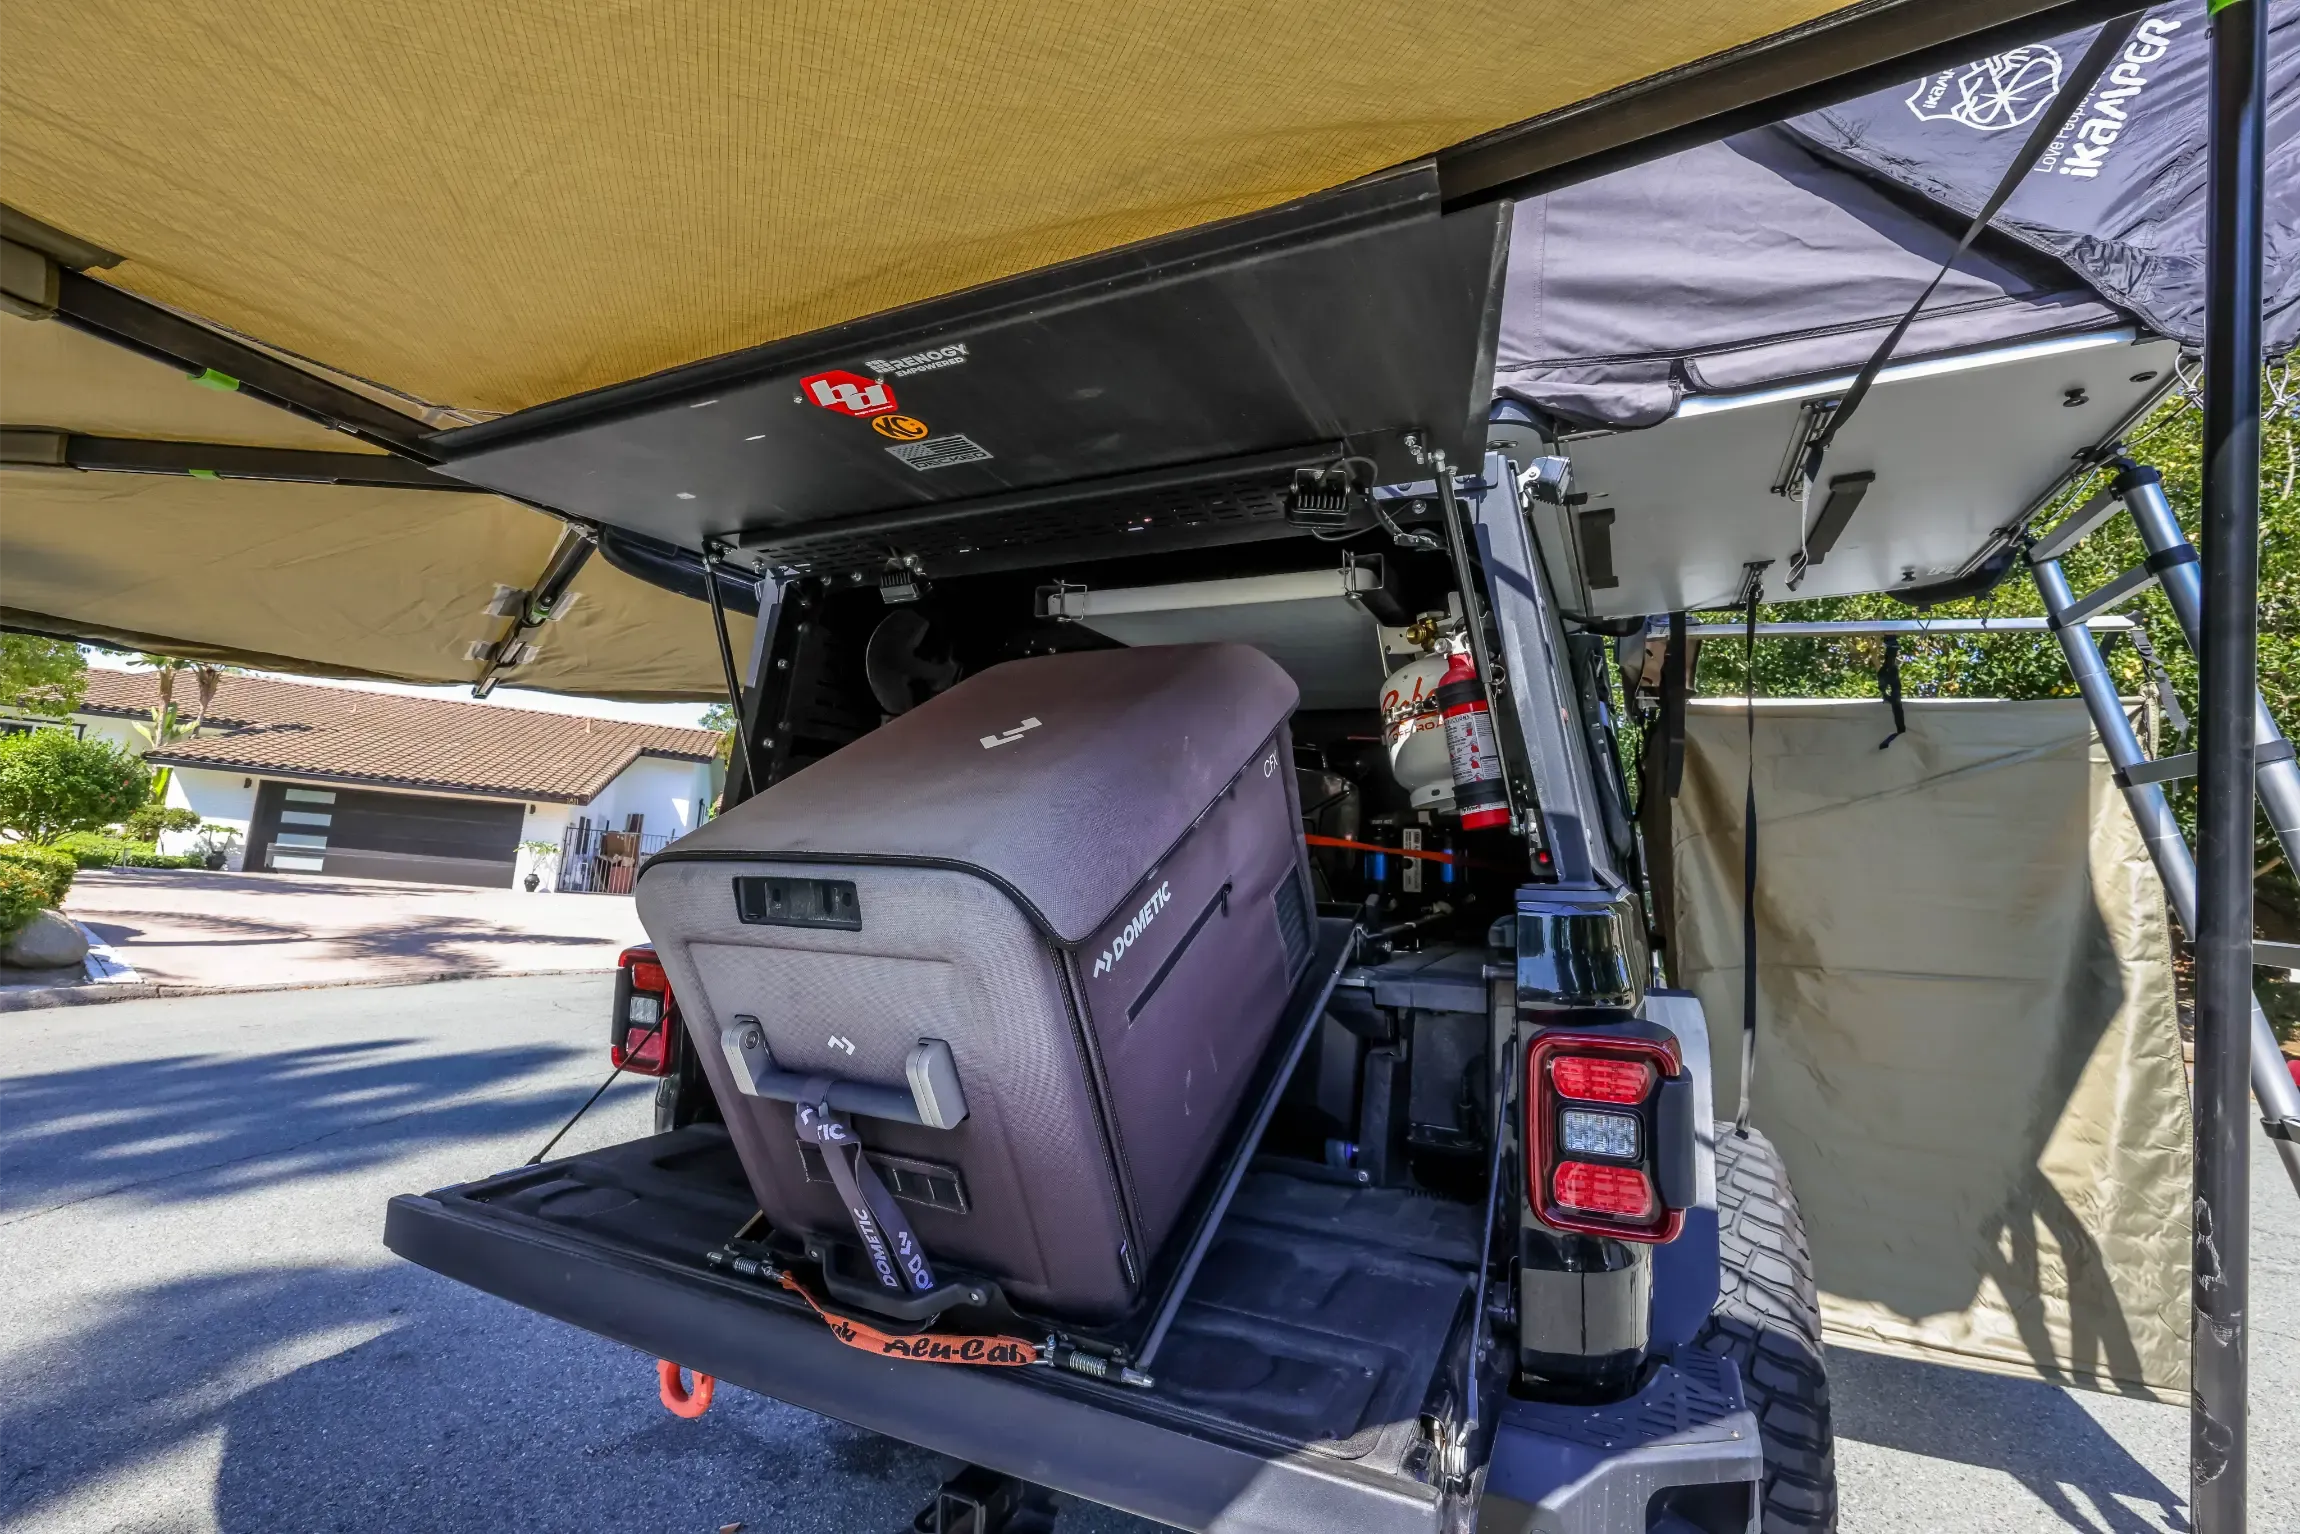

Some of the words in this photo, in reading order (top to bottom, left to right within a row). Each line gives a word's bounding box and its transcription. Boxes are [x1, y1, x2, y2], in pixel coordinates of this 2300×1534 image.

[2033, 141, 2065, 173] Love
[894, 343, 969, 370] RENOGY
[895, 356, 966, 377] EMPOWERED
[875, 416, 924, 438] KC
[913, 452, 987, 469] DECKED
[1393, 728, 1412, 741] OFF
[1263, 750, 1279, 778] CFX
[1112, 880, 1172, 962] DOMETIC
[854, 1207, 899, 1287] DOMETIC
